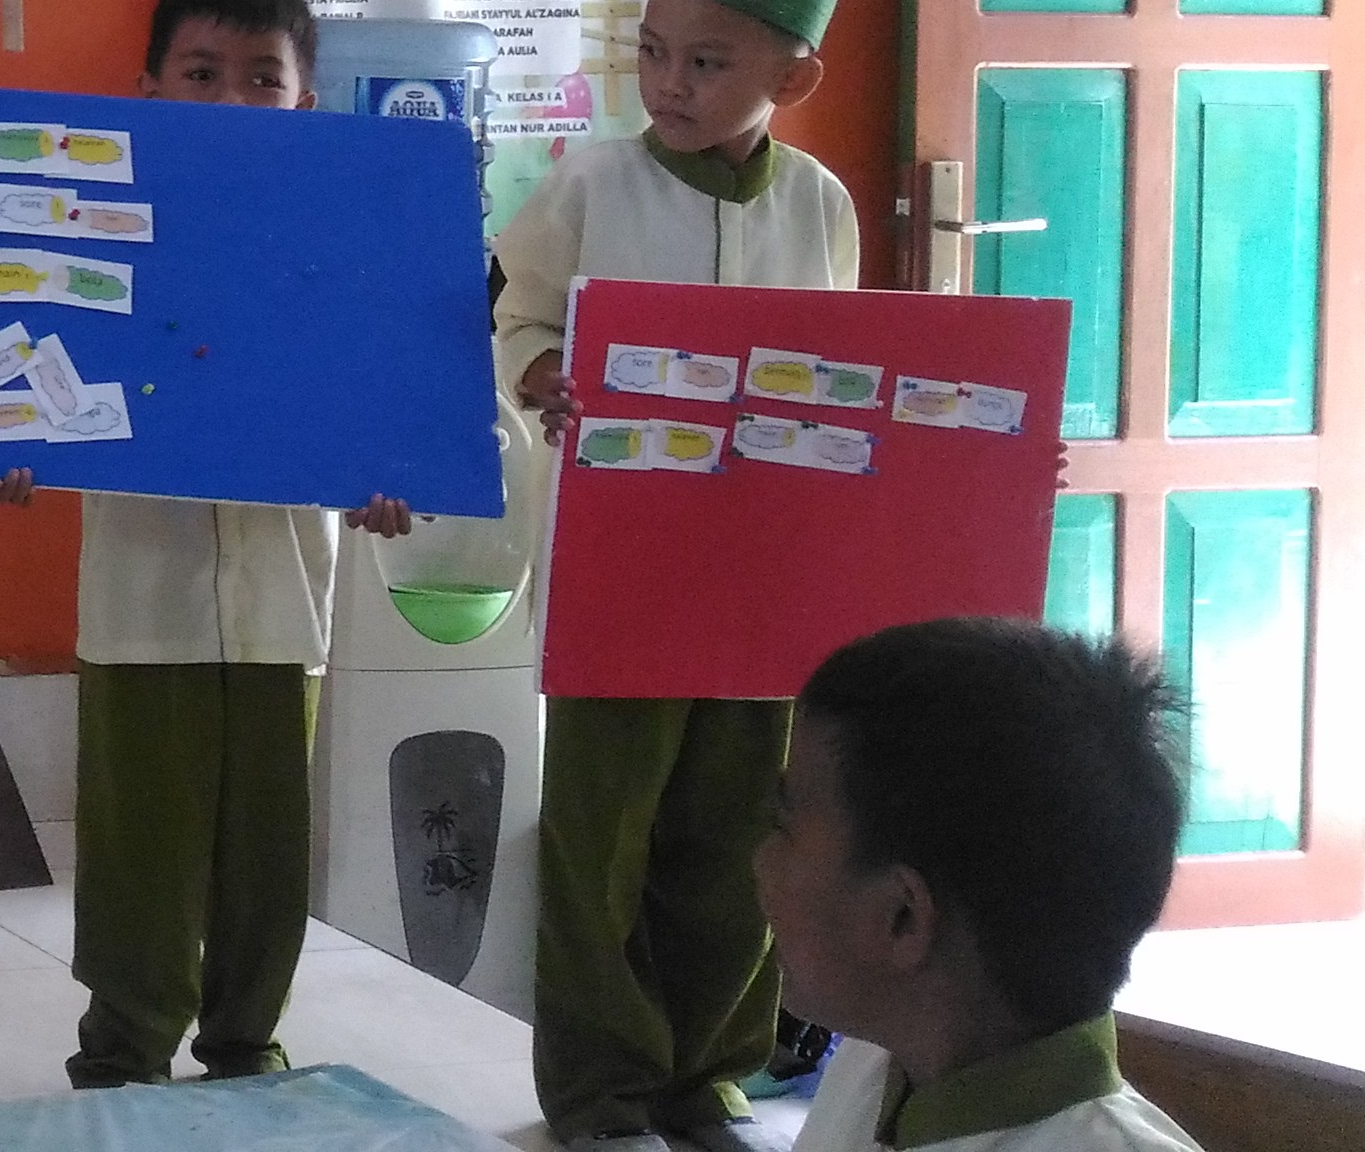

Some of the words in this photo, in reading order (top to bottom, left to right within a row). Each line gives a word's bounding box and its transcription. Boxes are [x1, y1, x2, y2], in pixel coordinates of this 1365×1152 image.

[507, 46, 538, 55] AULIA
[507, 92, 544, 103] KELAS
[554, 91, 563, 102] A
[520, 123, 545, 133] NUR
[547, 122, 588, 133] ADILLA
